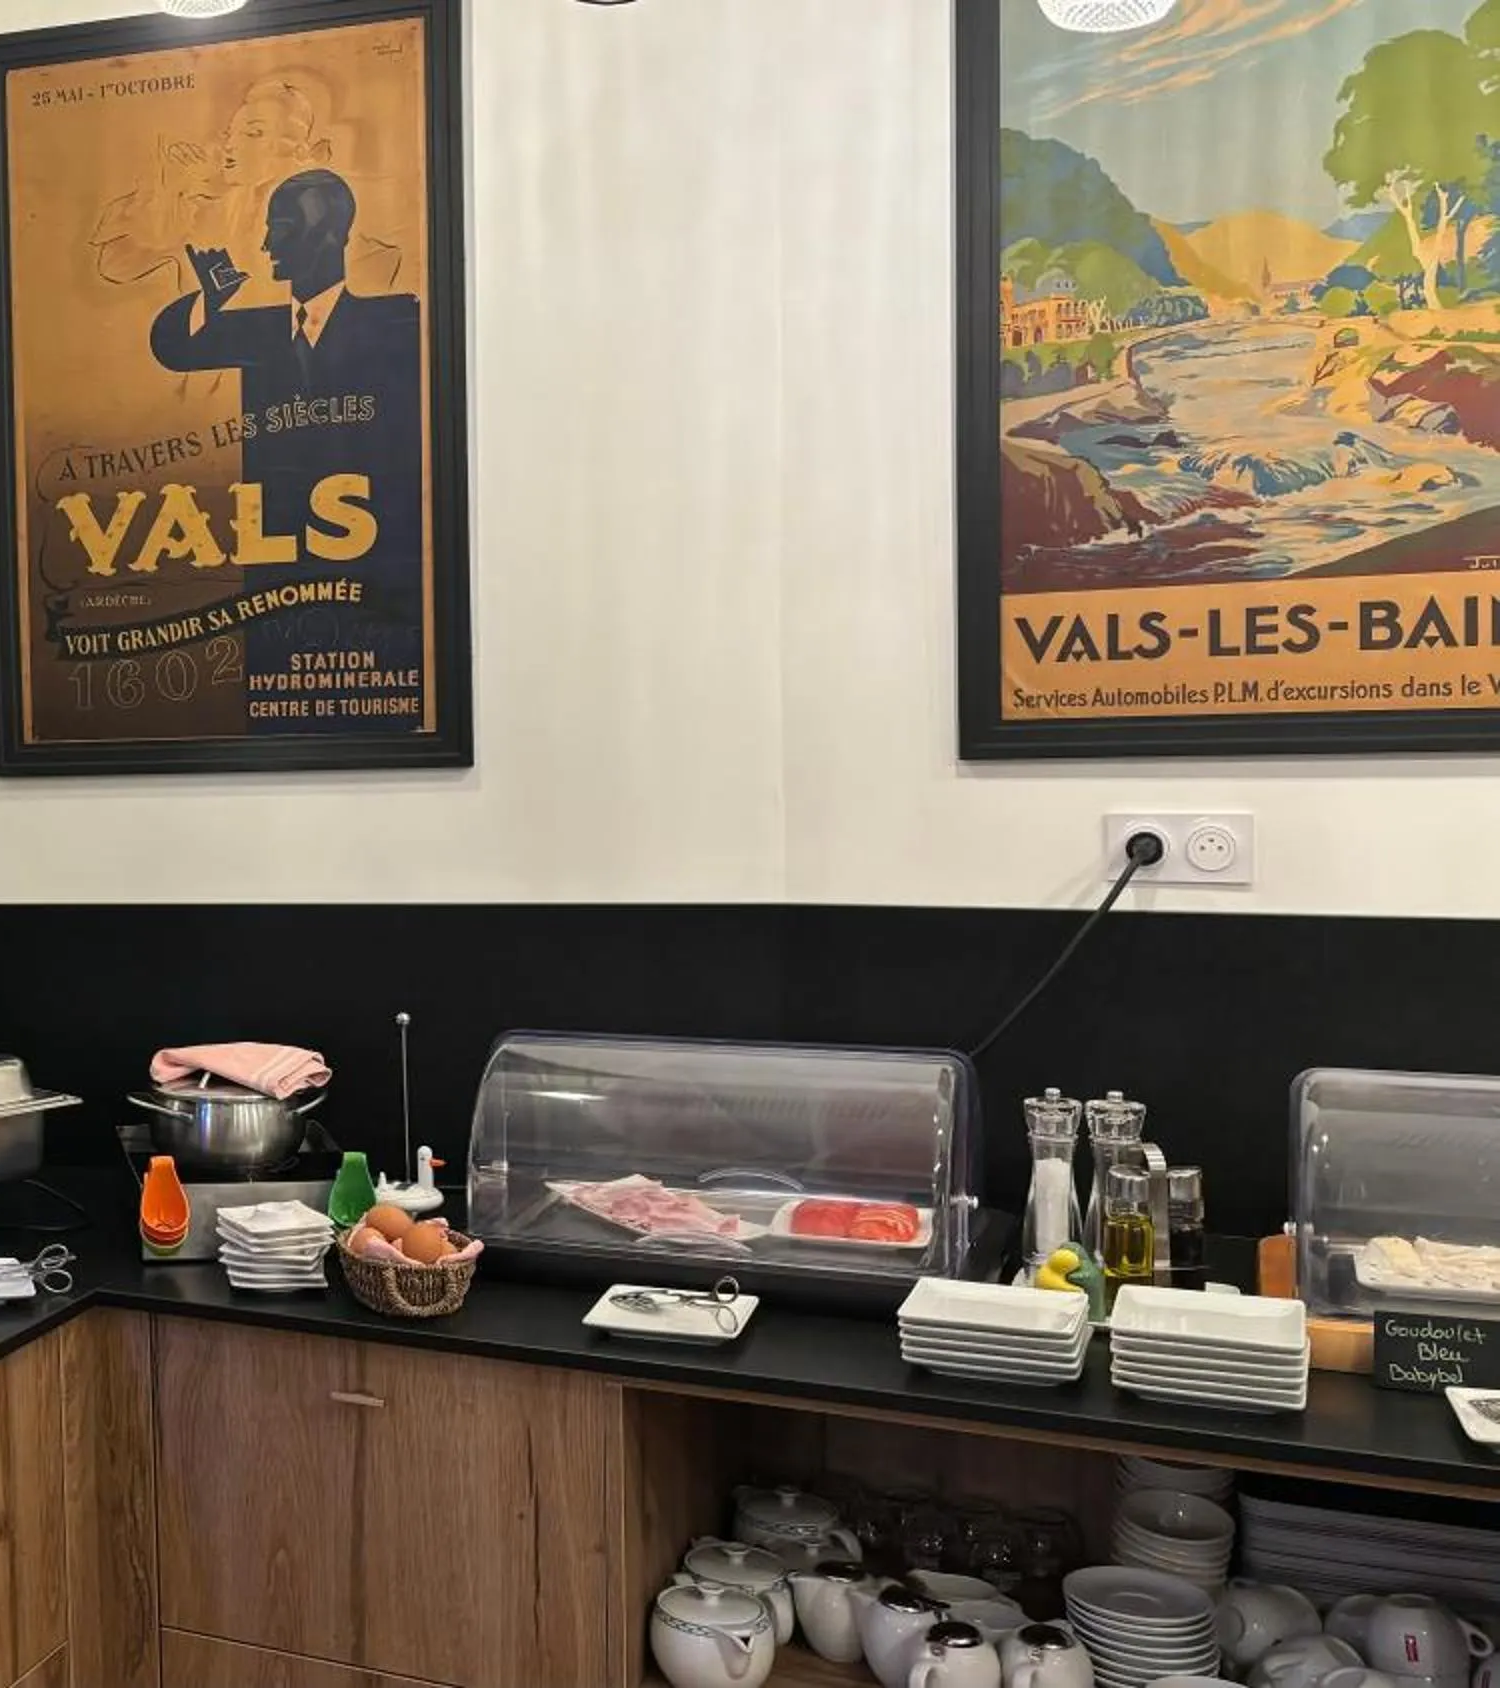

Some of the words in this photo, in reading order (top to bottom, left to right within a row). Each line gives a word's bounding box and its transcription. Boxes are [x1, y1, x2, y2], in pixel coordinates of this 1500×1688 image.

[55, 86, 83, 102] MAI
[115, 73, 195, 98] OCTOBRE
[83, 431, 202, 480] TRAVERS
[211, 413, 256, 449] LES
[265, 394, 376, 433] SIÈCLES
[56, 473, 379, 577] VALS
[65, 632, 111, 656] VOIT
[117, 618, 204, 651] GRANDIR
[207, 608, 233, 632] SA
[236, 577, 364, 621] RENOMMÉE
[1015, 595, 1500, 664] VALS-LES-BAI
[68, 635, 244, 711] 1602
[290, 650, 376, 671] STATION
[250, 700, 309, 717] CENTRE
[315, 699, 336, 716] DE
[339, 697, 420, 716] TOURISME
[1013, 687, 1088, 709] Services
[1091, 683, 1208, 708] Automobiles
[1267, 678, 1393, 701] d'excursions
[1402, 675, 1453, 699] dans
[1461, 673, 1482, 695] le
[1417, 1342, 1471, 1362] Bleu
[1388, 1363, 1464, 1390] Babybel
